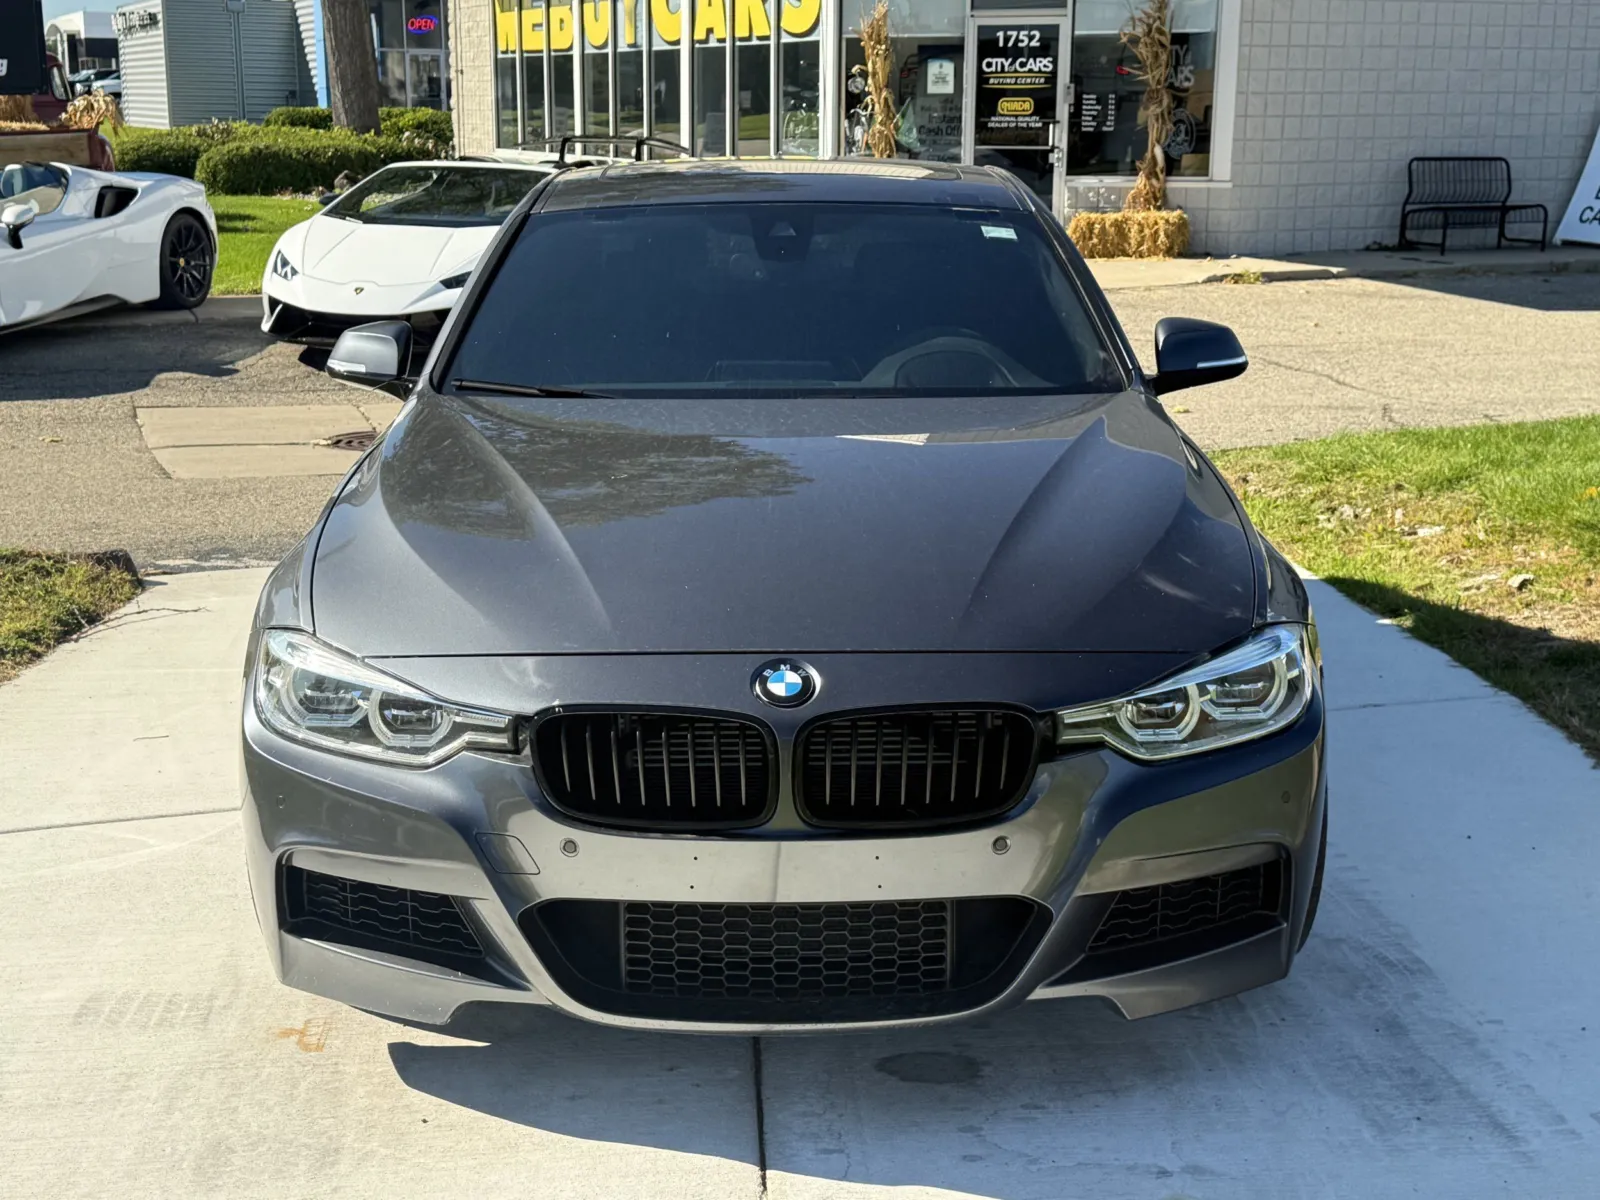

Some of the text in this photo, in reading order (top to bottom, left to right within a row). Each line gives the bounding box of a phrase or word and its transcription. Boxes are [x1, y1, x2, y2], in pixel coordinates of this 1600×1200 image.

[408, 17, 435, 30] OPEN
[650, 0, 822, 42] CARS
[996, 30, 1041, 48] 1752
[981, 57, 1013, 73] CITY
[1015, 56, 1054, 73] CARS
[988, 77, 1046, 85] BUYING CENTER
[1165, 65, 1195, 88] ARS
[762, 664, 810, 677] BMW
